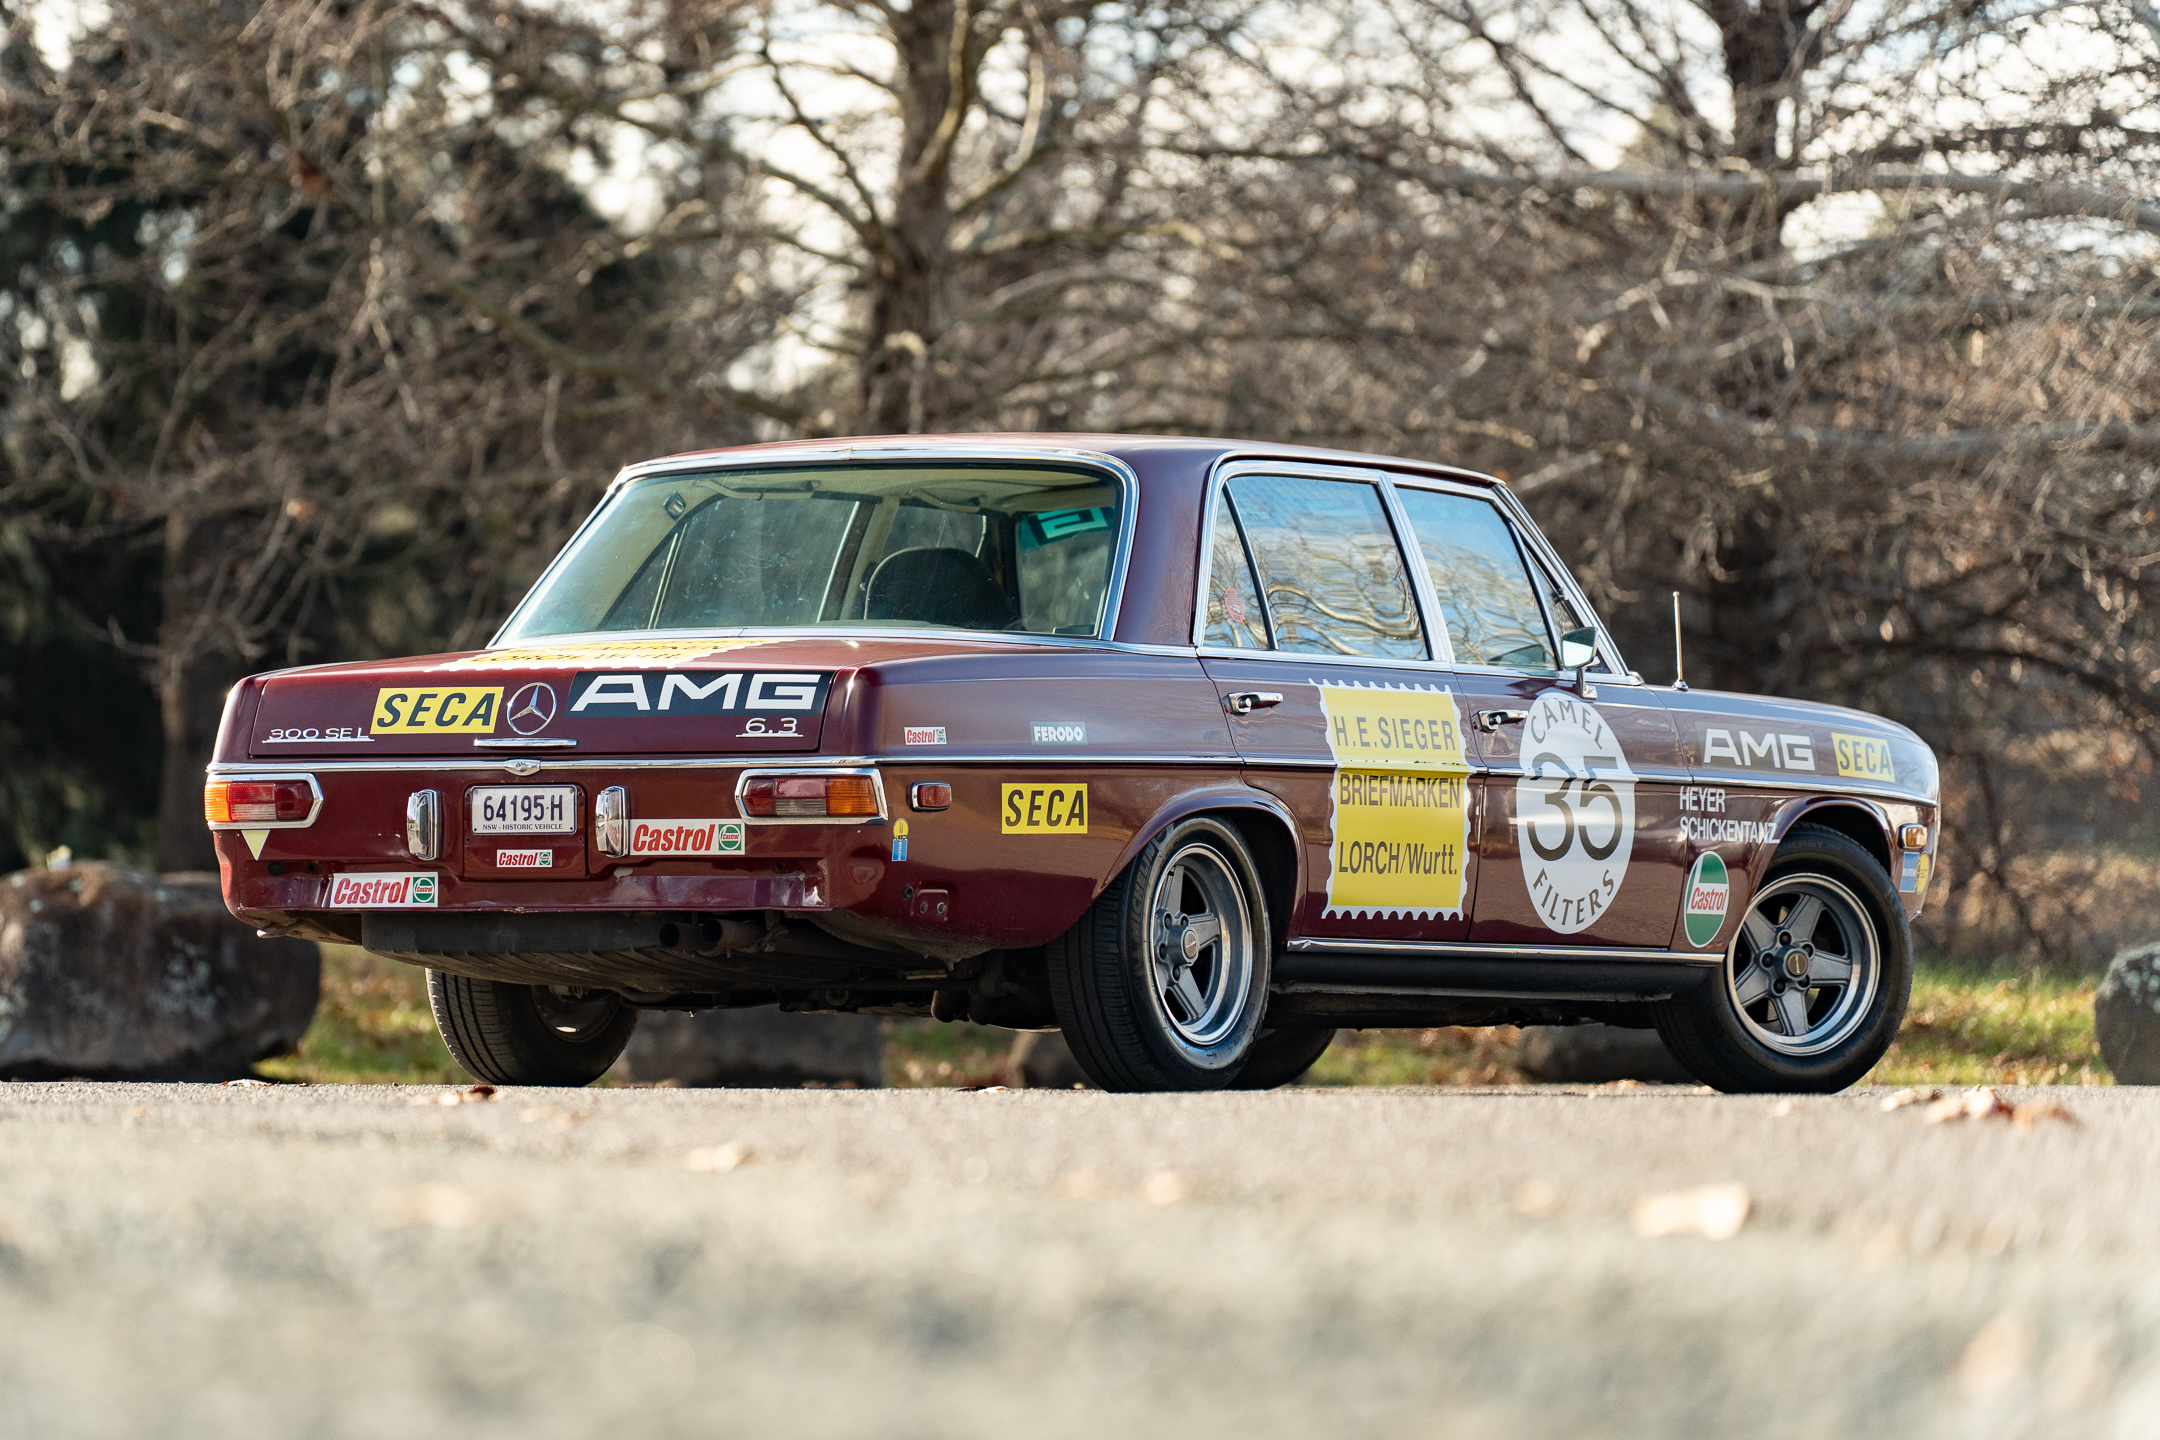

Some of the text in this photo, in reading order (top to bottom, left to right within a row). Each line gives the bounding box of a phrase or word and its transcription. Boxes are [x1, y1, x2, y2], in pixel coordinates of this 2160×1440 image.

[570, 674, 822, 712] AMG
[376, 692, 496, 728] SECA
[1530, 699, 1604, 750] CAMEL
[269, 728, 319, 739] 300
[745, 717, 798, 735] 6.3
[907, 729, 935, 743] Castrol
[1033, 726, 1083, 742] FERODO
[1703, 728, 1816, 771] AMG
[1838, 738, 1893, 776] SECA
[1340, 773, 1461, 809] BRIEFMARKEN
[1679, 786, 1726, 813] HEYER
[1005, 789, 1085, 827] SECA
[1527, 752, 1623, 862] 35
[482, 823, 498, 831] NSW
[502, 823, 533, 831] HISTORIC
[534, 822, 563, 830] VEHICLE
[633, 823, 716, 852] Castrol
[1679, 816, 1780, 844] SCHICKENTANZ
[498, 852, 539, 866] Castrol
[1338, 841, 1458, 875] LORCH/Wurtt.
[333, 877, 411, 905] Castrol
[1532, 868, 1615, 926] FILTERS
[1690, 886, 1728, 911] Castrol
